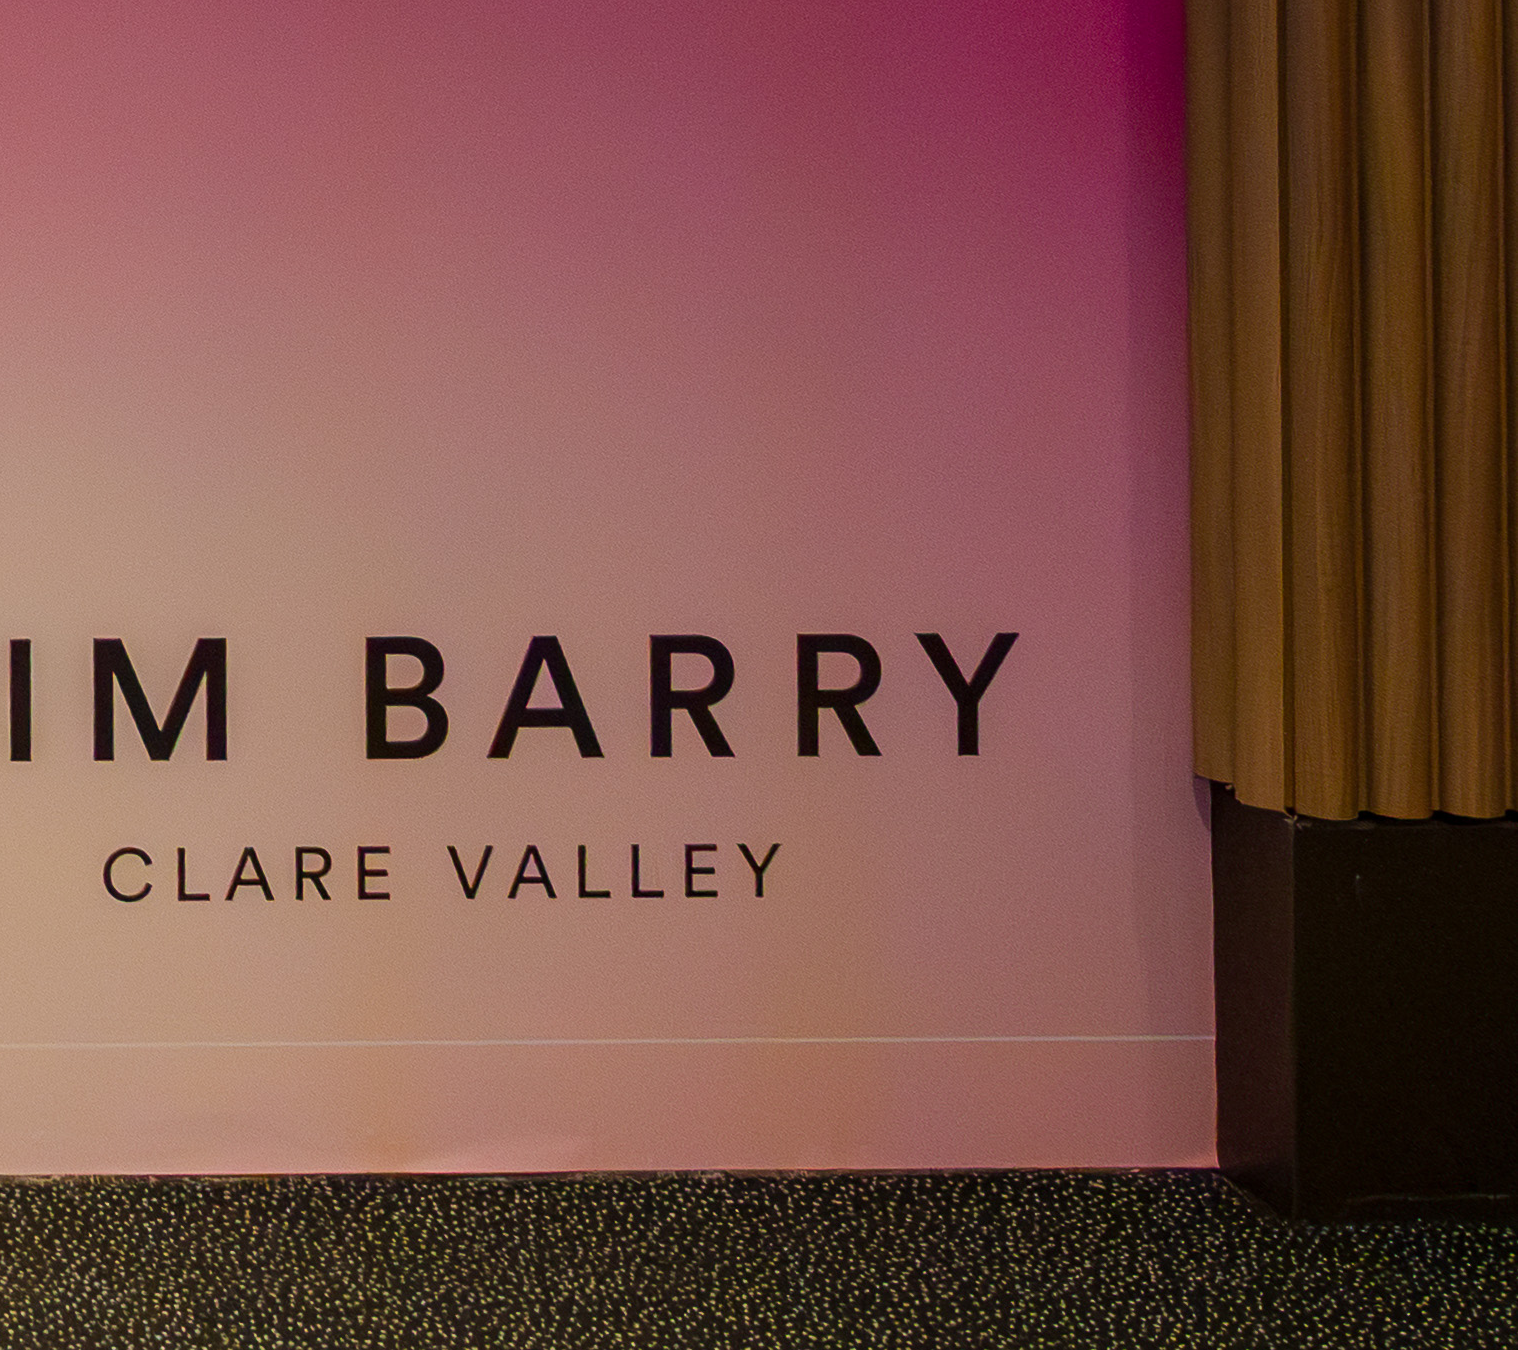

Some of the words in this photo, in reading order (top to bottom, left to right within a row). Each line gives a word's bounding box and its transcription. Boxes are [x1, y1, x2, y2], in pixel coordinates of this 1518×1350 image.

[365, 632, 1020, 761] BARRY
[101, 844, 393, 904] CLARE
[445, 842, 784, 901] VALLEY
